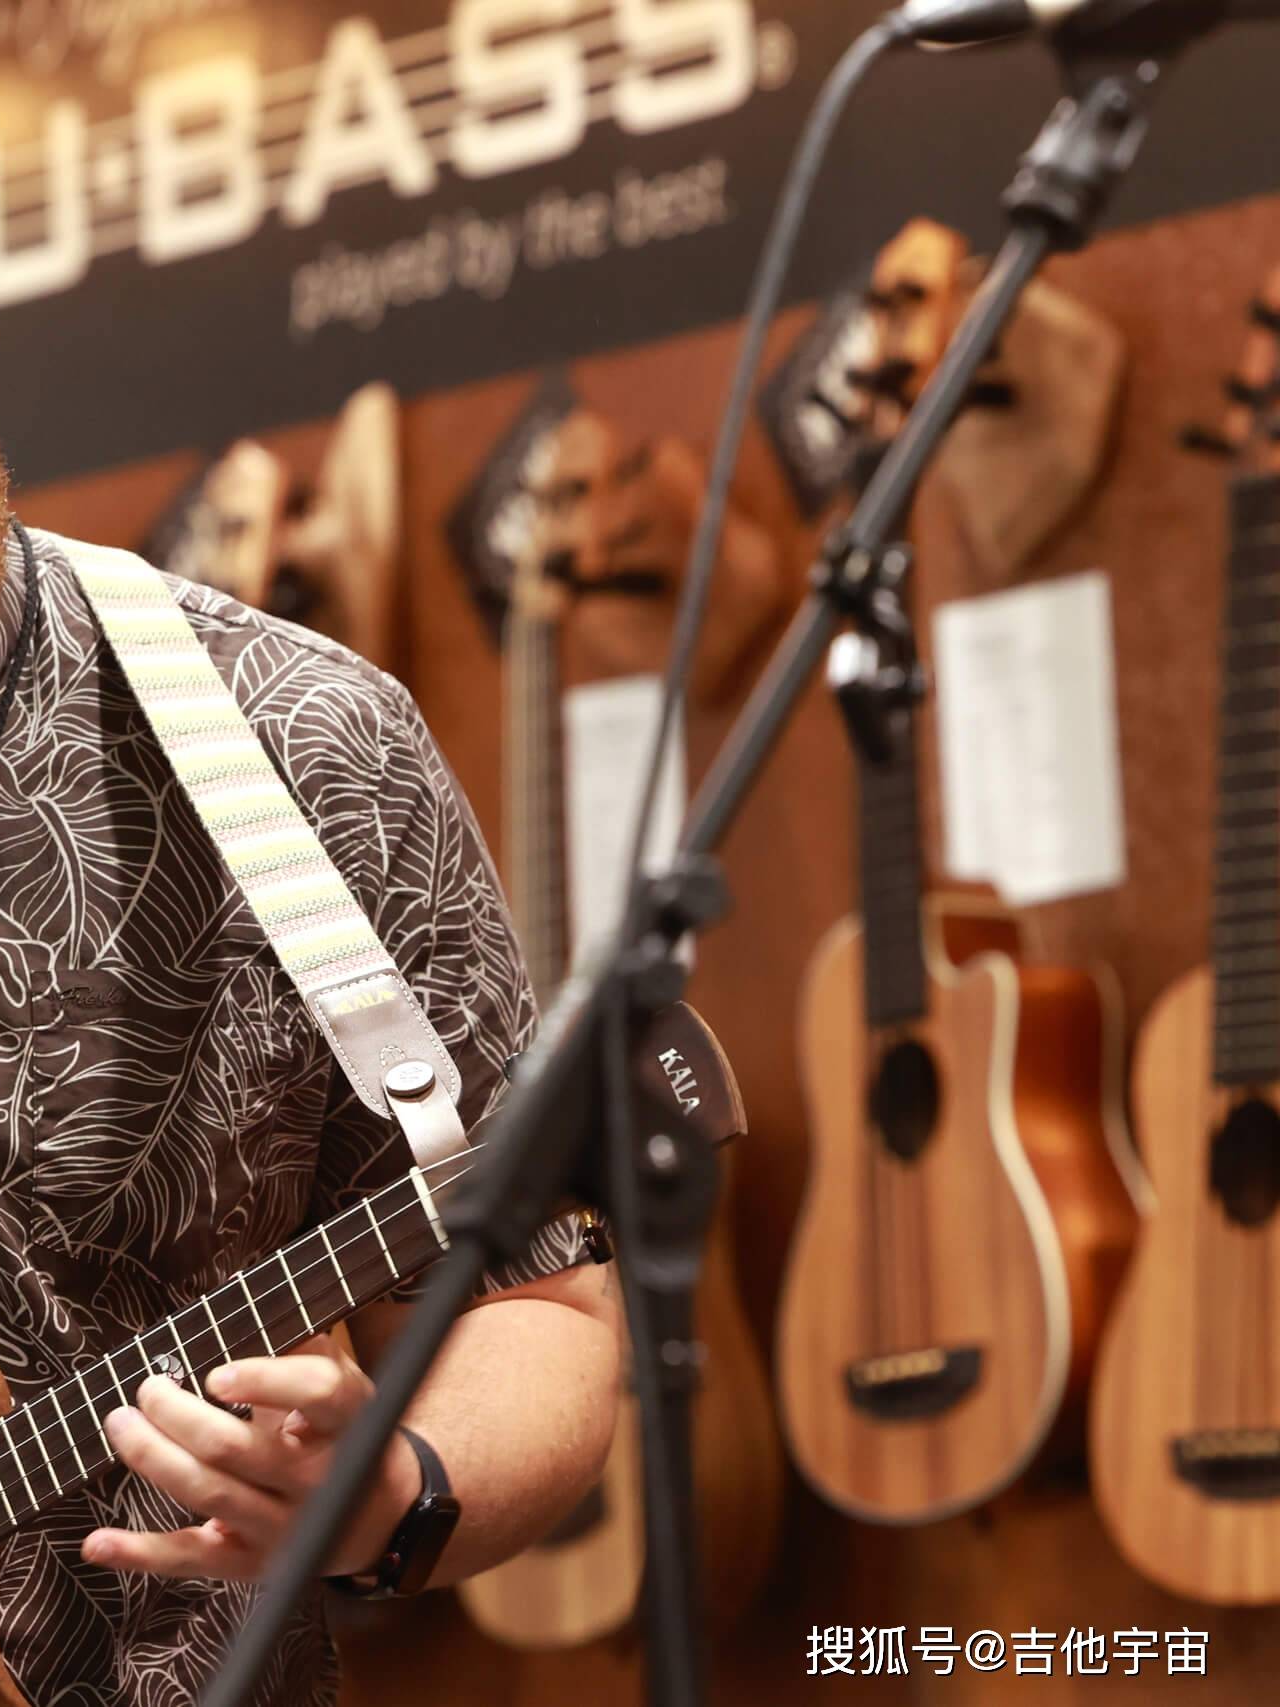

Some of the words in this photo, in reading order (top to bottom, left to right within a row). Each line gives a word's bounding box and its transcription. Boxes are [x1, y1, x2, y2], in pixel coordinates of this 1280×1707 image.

[288, 216, 452, 338] played
[454, 209, 514, 300] by
[525, 189, 611, 270] the
[658, 1048, 701, 1116] KALA
